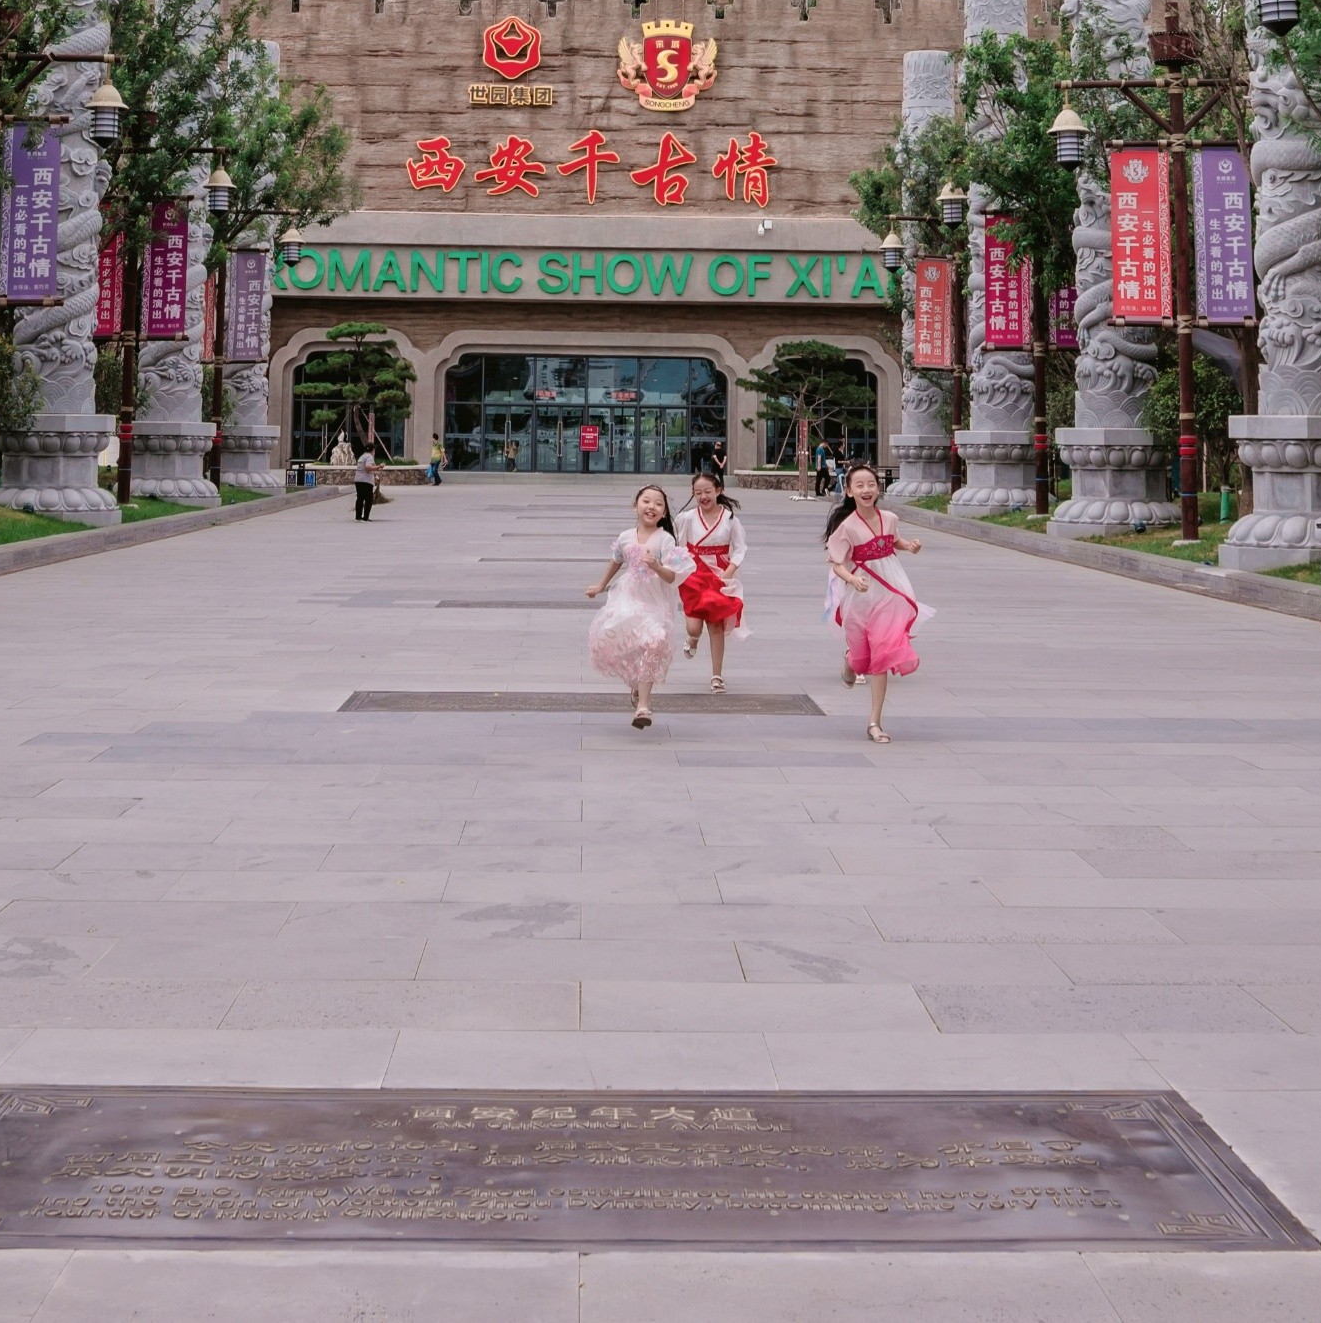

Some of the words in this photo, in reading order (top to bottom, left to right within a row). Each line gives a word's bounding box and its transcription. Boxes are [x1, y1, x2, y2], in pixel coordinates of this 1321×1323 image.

[468, 84, 553, 106] 世园集团
[644, 98, 690, 109] SONGCHENG
[405, 129, 777, 208] 西安千古情
[13, 184, 29, 278] 一生必看的演出
[29, 167, 54, 278] 西安千古情
[1116, 192, 1141, 300] 西安千古情
[1141, 210, 1156, 300] 一生必看的演出
[1208, 209, 1224, 300] 一生必看的演出
[1222, 192, 1249, 300] 西安千古情
[152, 247, 165, 320] 一生必看的演出
[164, 234, 184, 320] 西安千古情
[245, 279, 262, 349] 西安千古情
[537, 252, 693, 296] SHOW
[708, 254, 773, 296] OF
[785, 255, 903, 298] XI'A
[989, 247, 1007, 331] 西安千古情
[1007, 268, 1019, 331] 必看的演出
[918, 286, 934, 355] 西安千古情
[411, 1105, 758, 1121] 西安纪年大道
